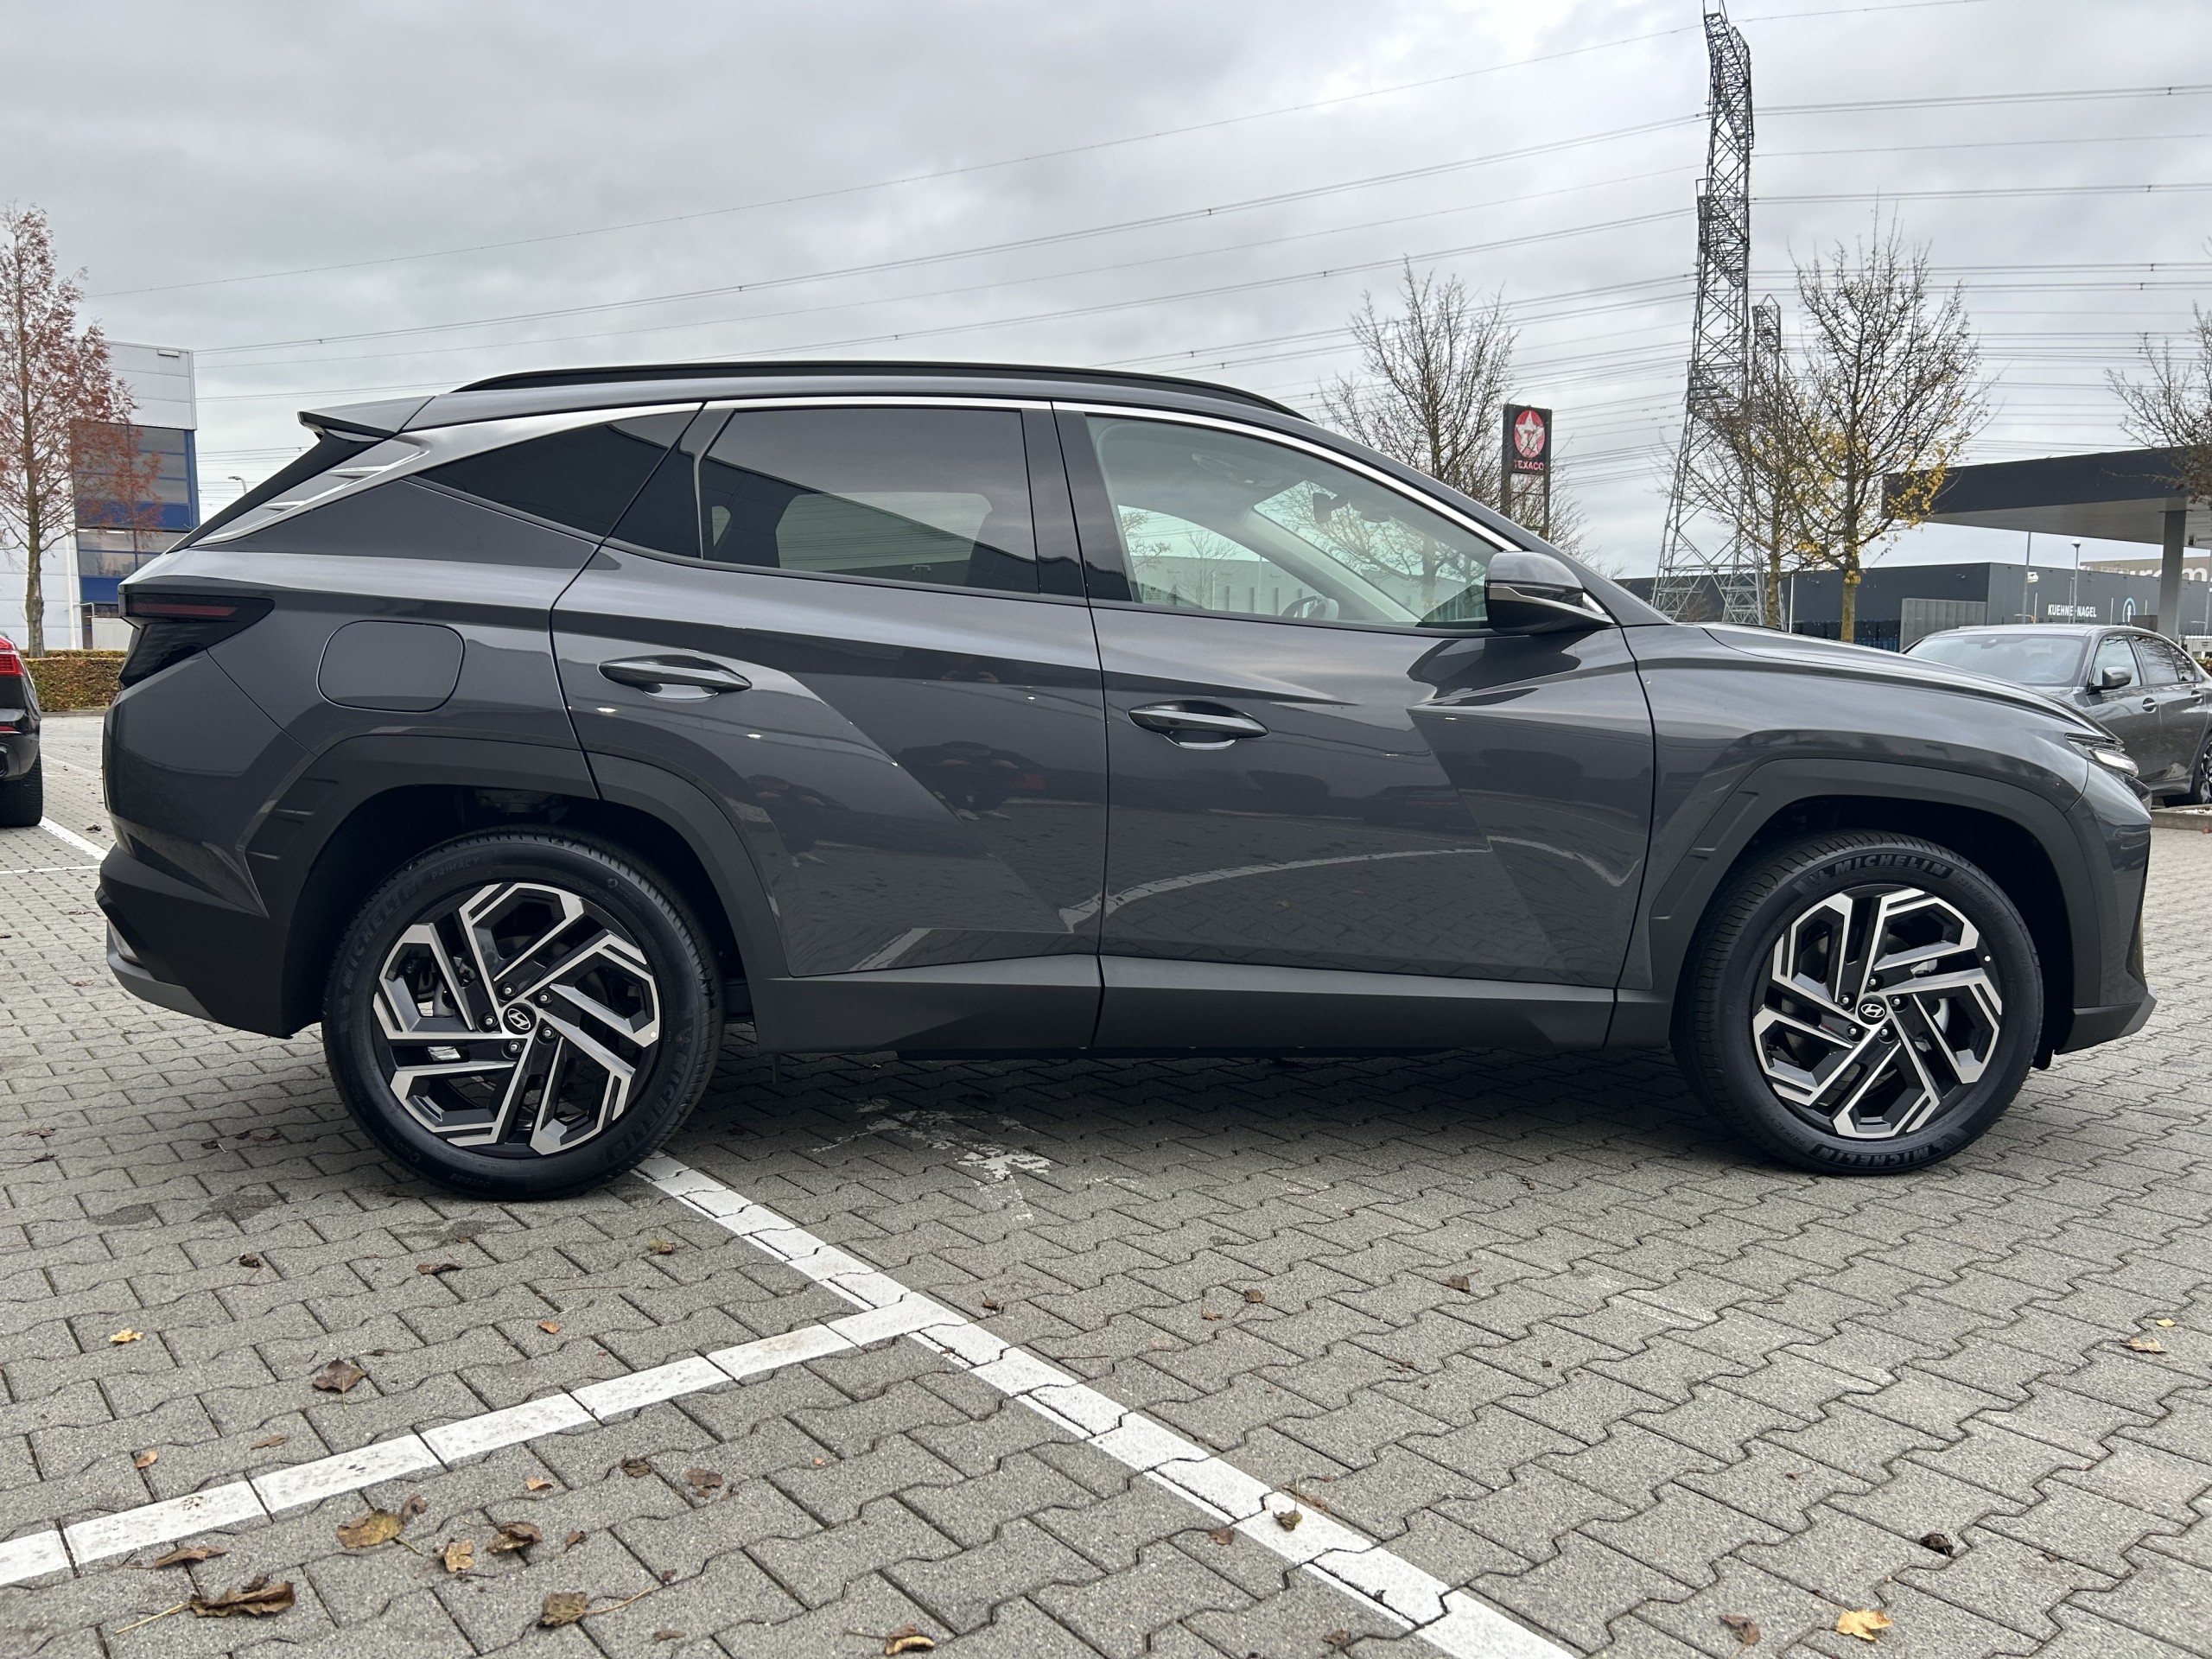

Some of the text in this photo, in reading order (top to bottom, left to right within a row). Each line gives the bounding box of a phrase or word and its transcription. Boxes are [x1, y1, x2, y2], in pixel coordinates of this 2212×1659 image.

[1514, 460, 1544, 471] TEXACO
[2048, 604, 2097, 618] KUEHNE NAGEL
[432, 857, 480, 880] PRIMACY
[1834, 854, 1948, 876] MICHELIN
[343, 880, 418, 990] MICHELIN
[1771, 1116, 1806, 1147] PRIMACY
[1816, 1146, 1930, 1166] MICHELIN
